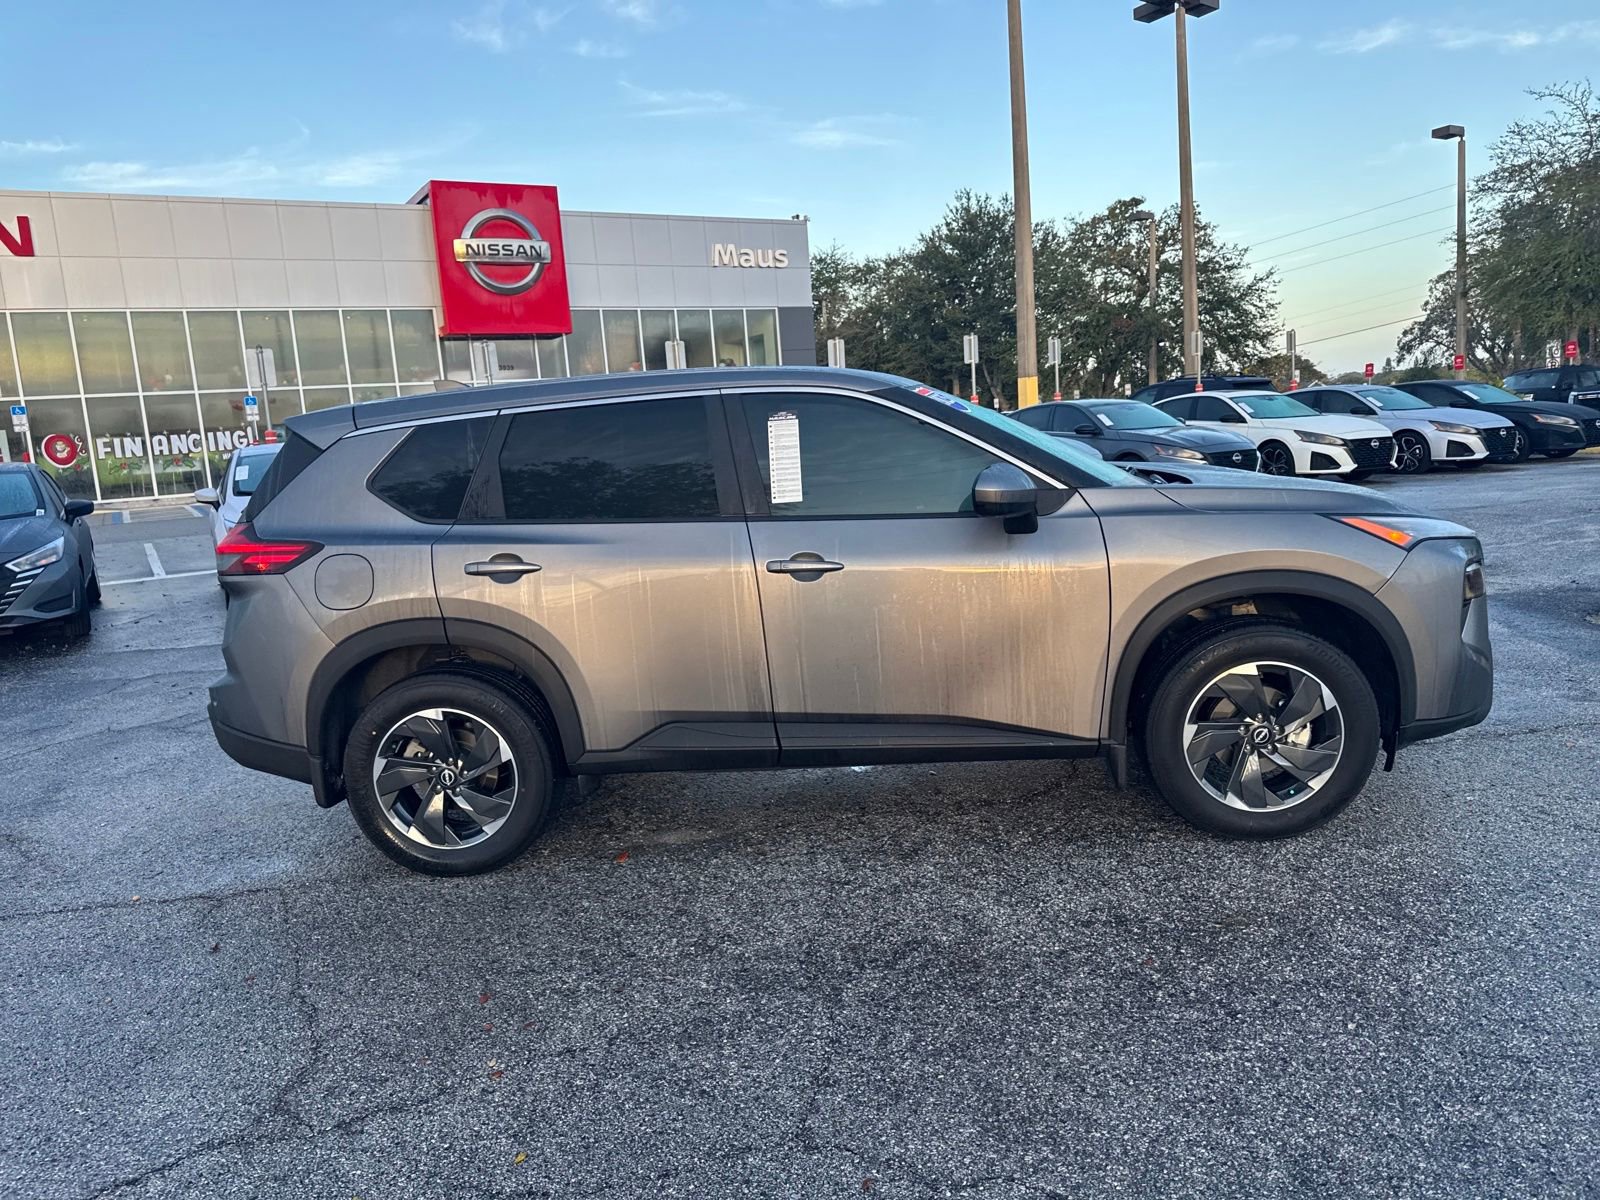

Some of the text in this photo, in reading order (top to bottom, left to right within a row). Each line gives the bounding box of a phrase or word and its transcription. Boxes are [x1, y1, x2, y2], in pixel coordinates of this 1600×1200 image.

[465, 243, 543, 258] NISSAN
[712, 243, 789, 268] Maus
[96, 426, 254, 460] FINANCING!
